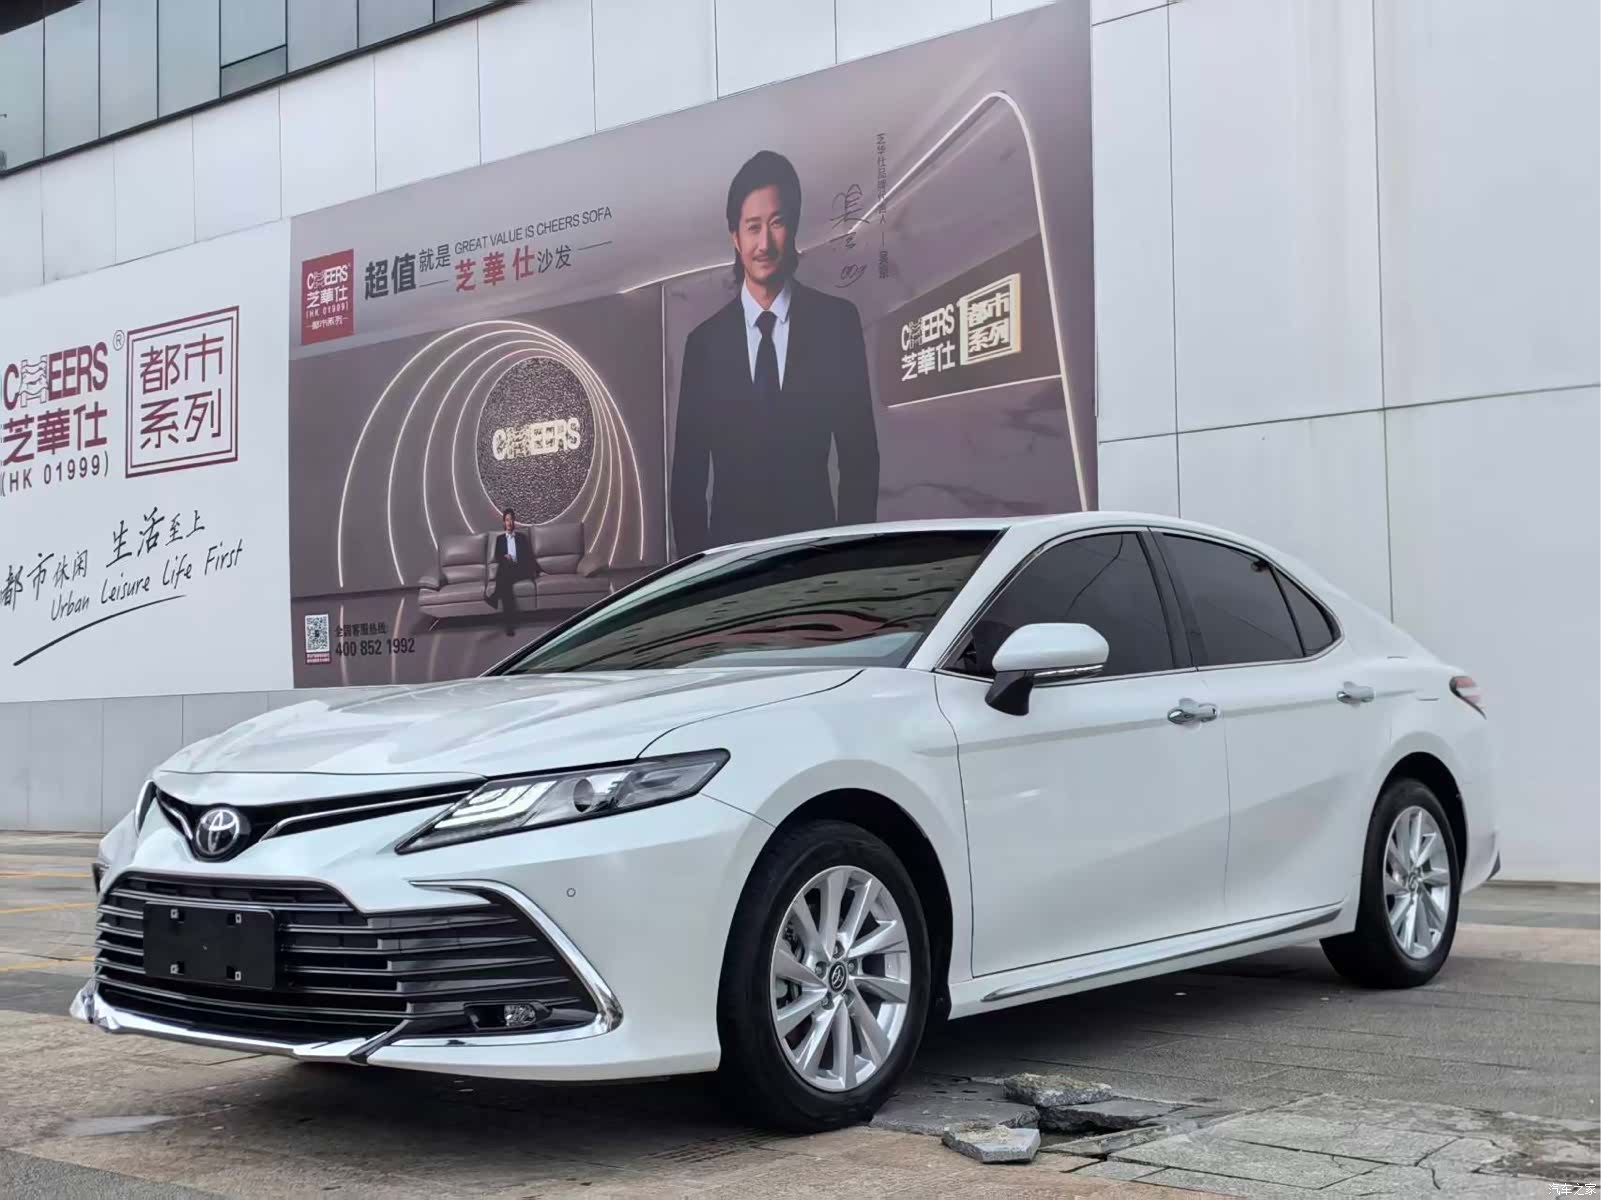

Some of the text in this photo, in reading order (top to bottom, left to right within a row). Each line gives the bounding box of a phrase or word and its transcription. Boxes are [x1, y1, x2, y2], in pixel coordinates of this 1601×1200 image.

[454, 206, 612, 255] GREAT VALUE IS CHEERS SOFA
[306, 285, 349, 309] 芝華仕
[967, 292, 1010, 328] 都市
[901, 303, 955, 351] CHEERS
[967, 318, 1010, 353] 系列
[3, 341, 108, 411] CHEERS
[140, 333, 225, 395] 都市
[901, 340, 956, 382] 芝華仕
[2, 401, 107, 466] 芝華仕
[140, 388, 223, 450] 系列
[492, 417, 581, 461] CHEERS
[0, 451, 109, 497] (HK 01999)
[0, 506, 206, 611] 都市休闲 生活至上
[51, 539, 243, 621] Urban Leisure Life First
[336, 638, 415, 656] 400 852 1992
